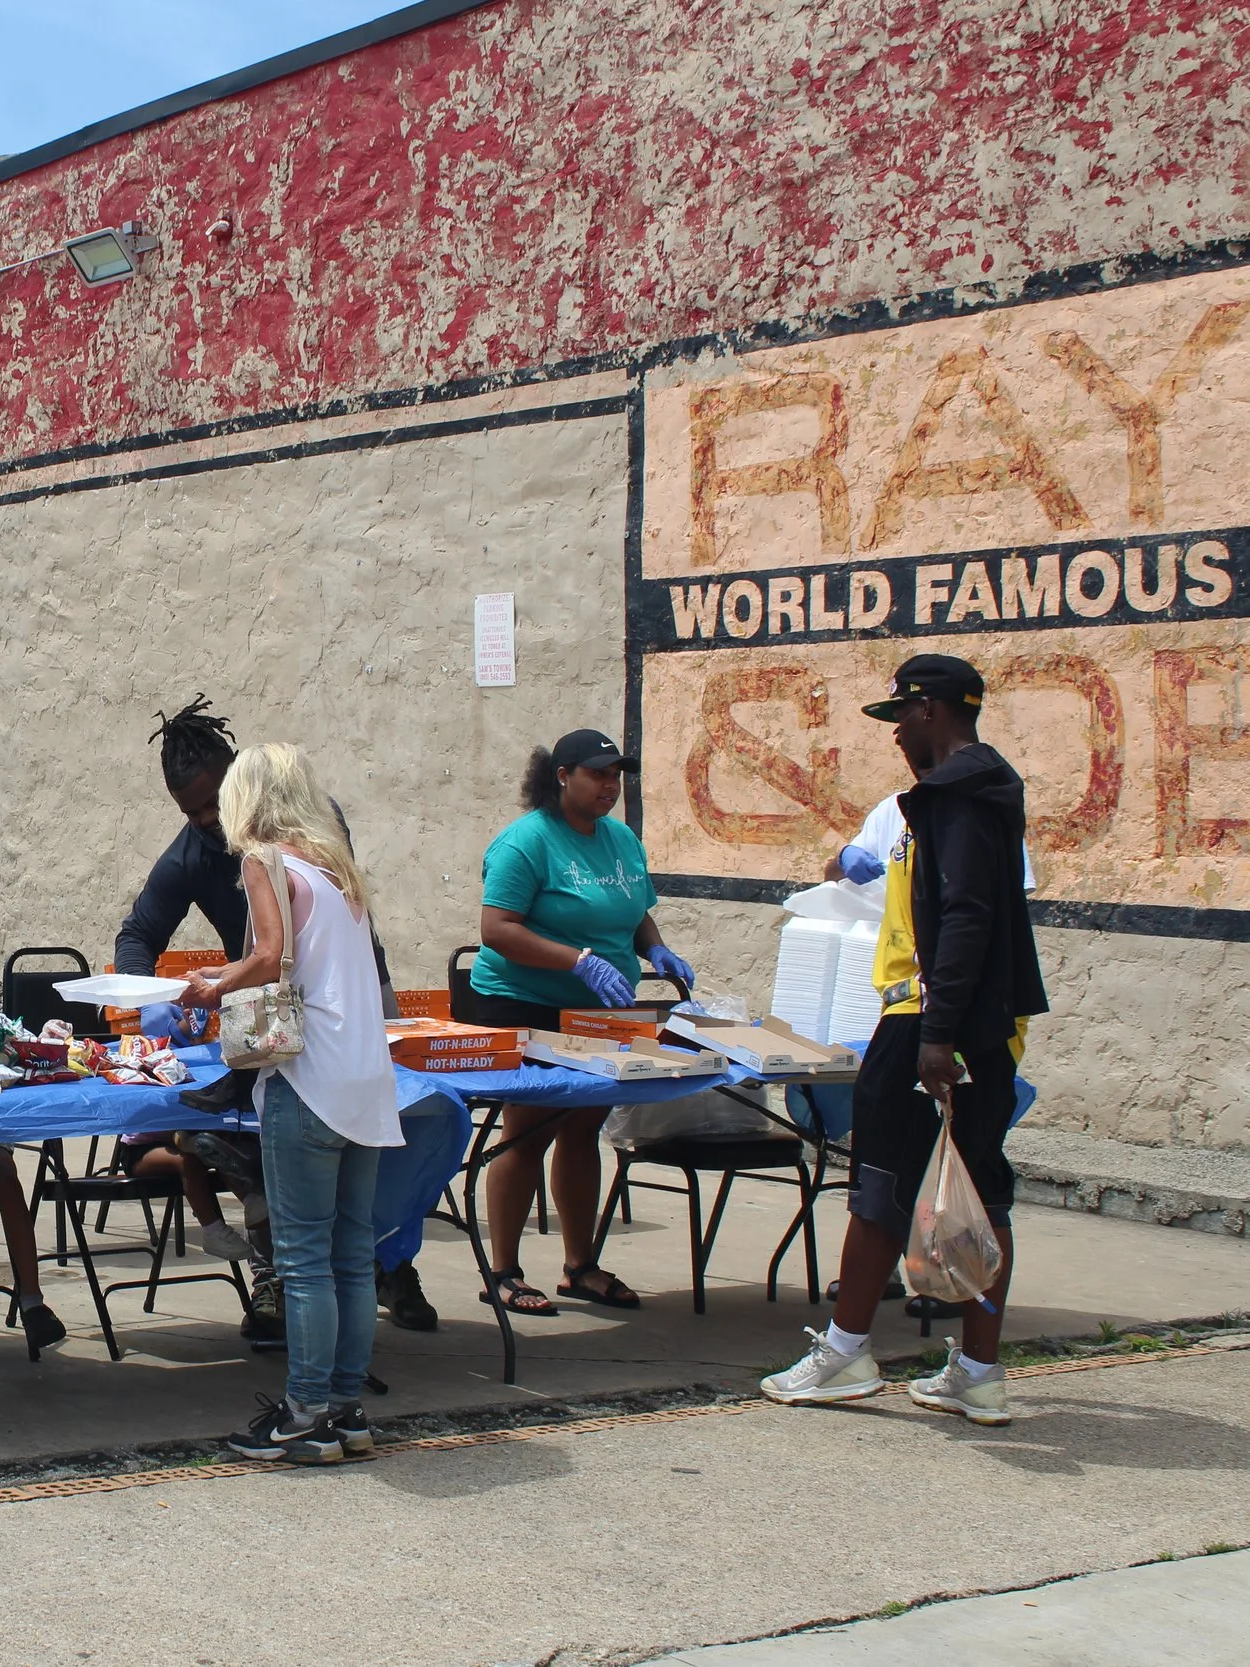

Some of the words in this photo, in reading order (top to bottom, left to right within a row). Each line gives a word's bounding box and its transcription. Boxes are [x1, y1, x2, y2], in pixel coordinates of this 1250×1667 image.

[669, 570, 892, 639] WORLD
[915, 540, 1233, 625] FAMOUS
[430, 1036, 494, 1051] HOT-N-READY
[425, 1056, 495, 1070] HOT-N-READY
